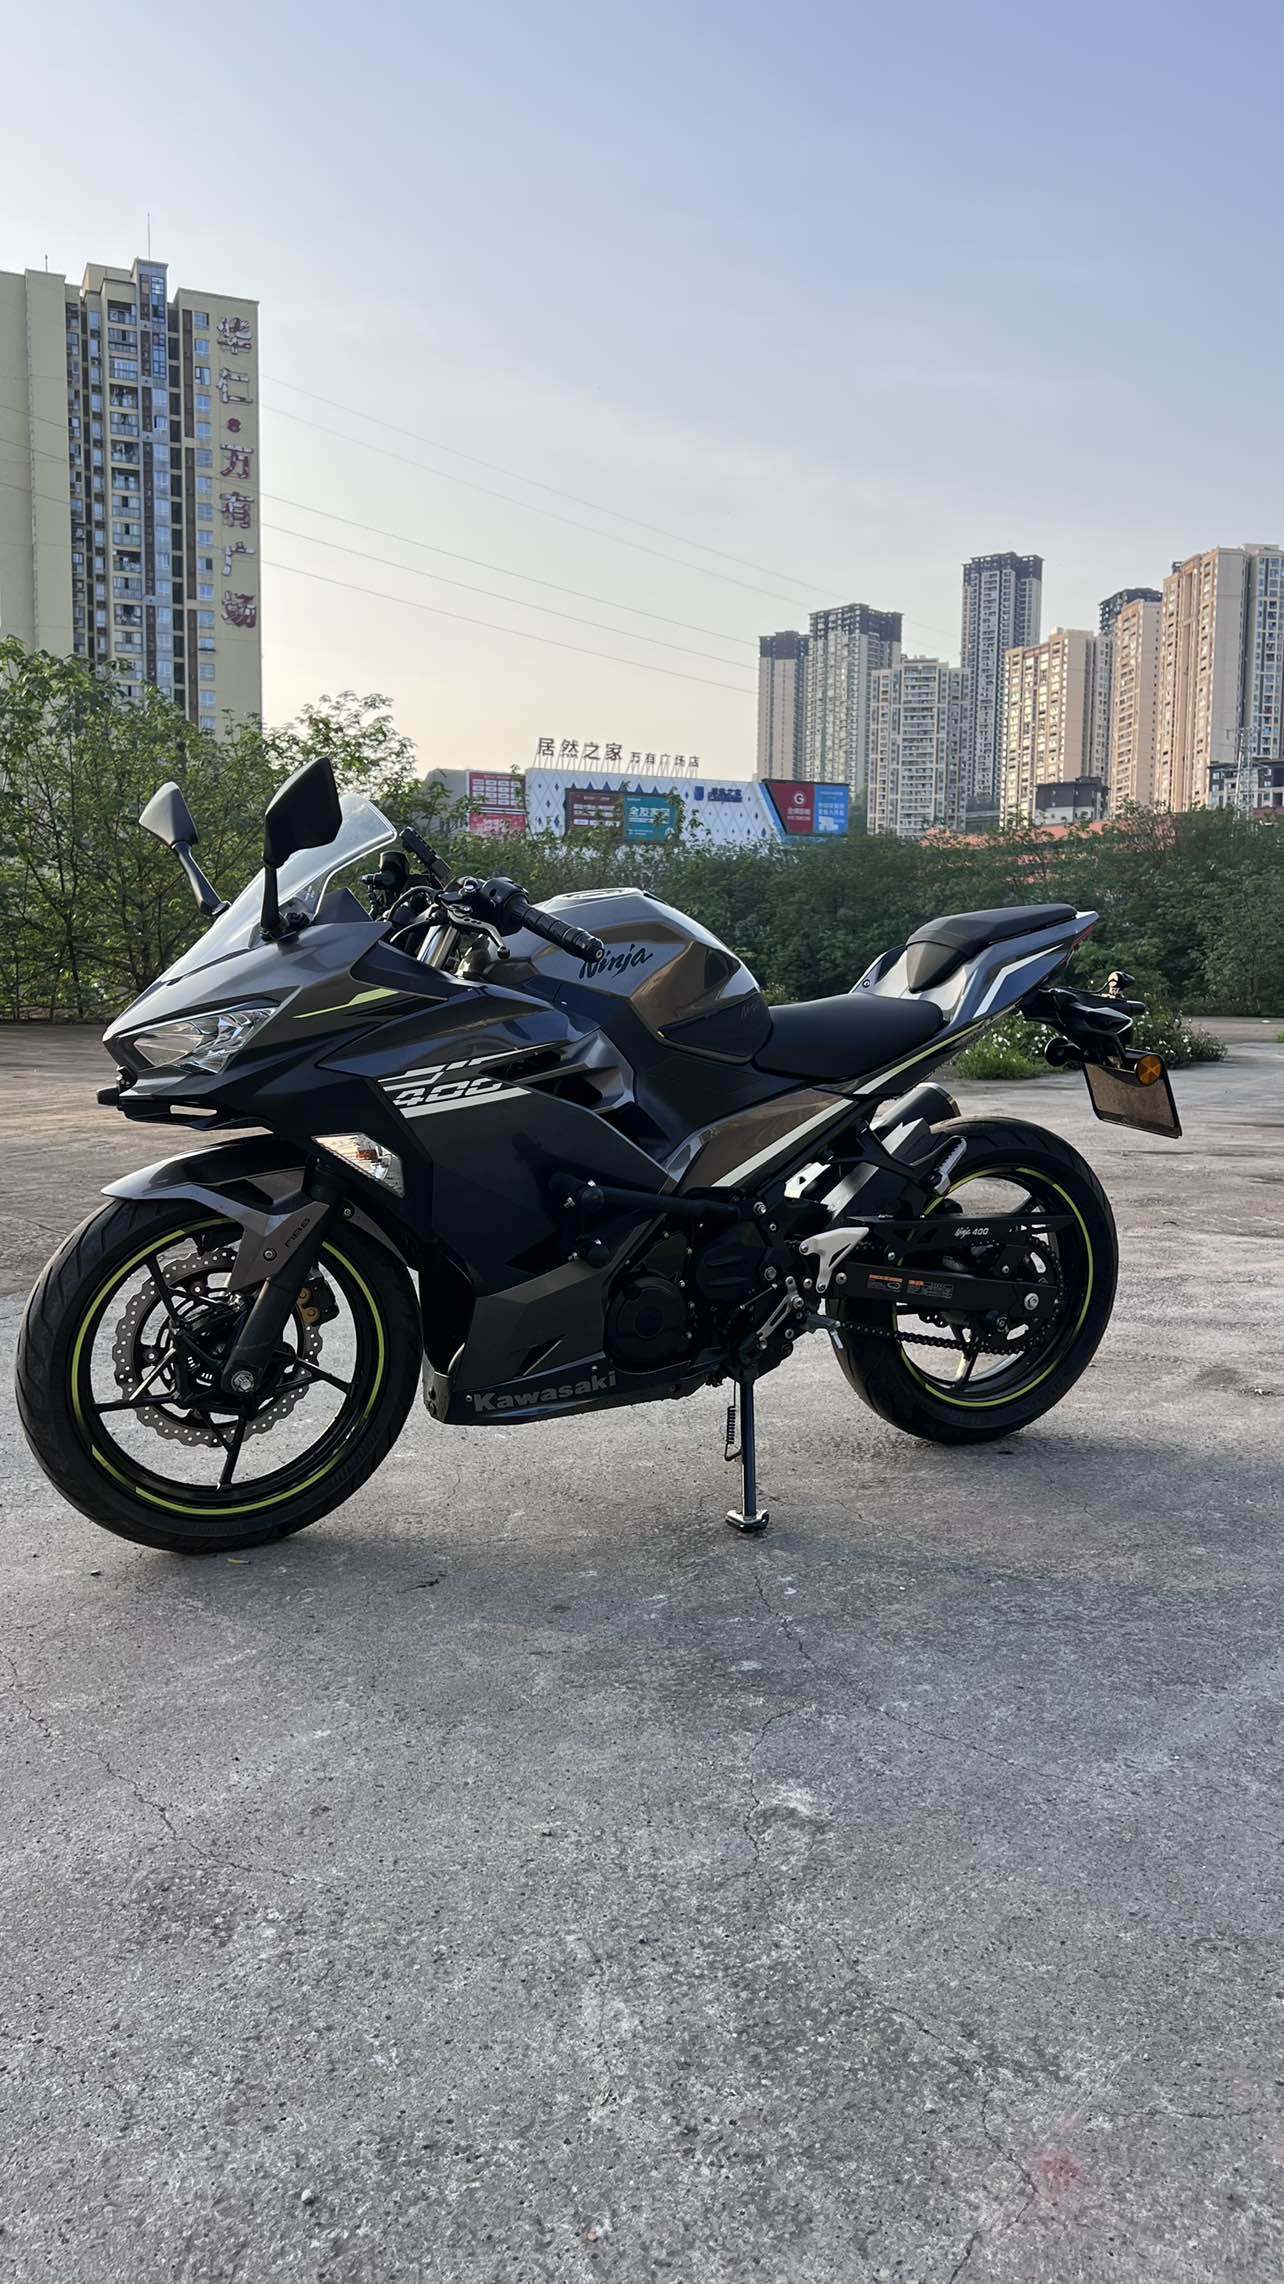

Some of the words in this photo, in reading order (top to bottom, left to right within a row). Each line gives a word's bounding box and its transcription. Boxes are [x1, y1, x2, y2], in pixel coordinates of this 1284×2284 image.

[537, 737, 624, 761] 居然之家
[630, 751, 700, 768] 万有广场店
[579, 944, 654, 979] Ninja
[392, 1077, 503, 1107] 400
[972, 1227, 989, 1236] 400
[473, 1371, 617, 1412] Kawasaki
